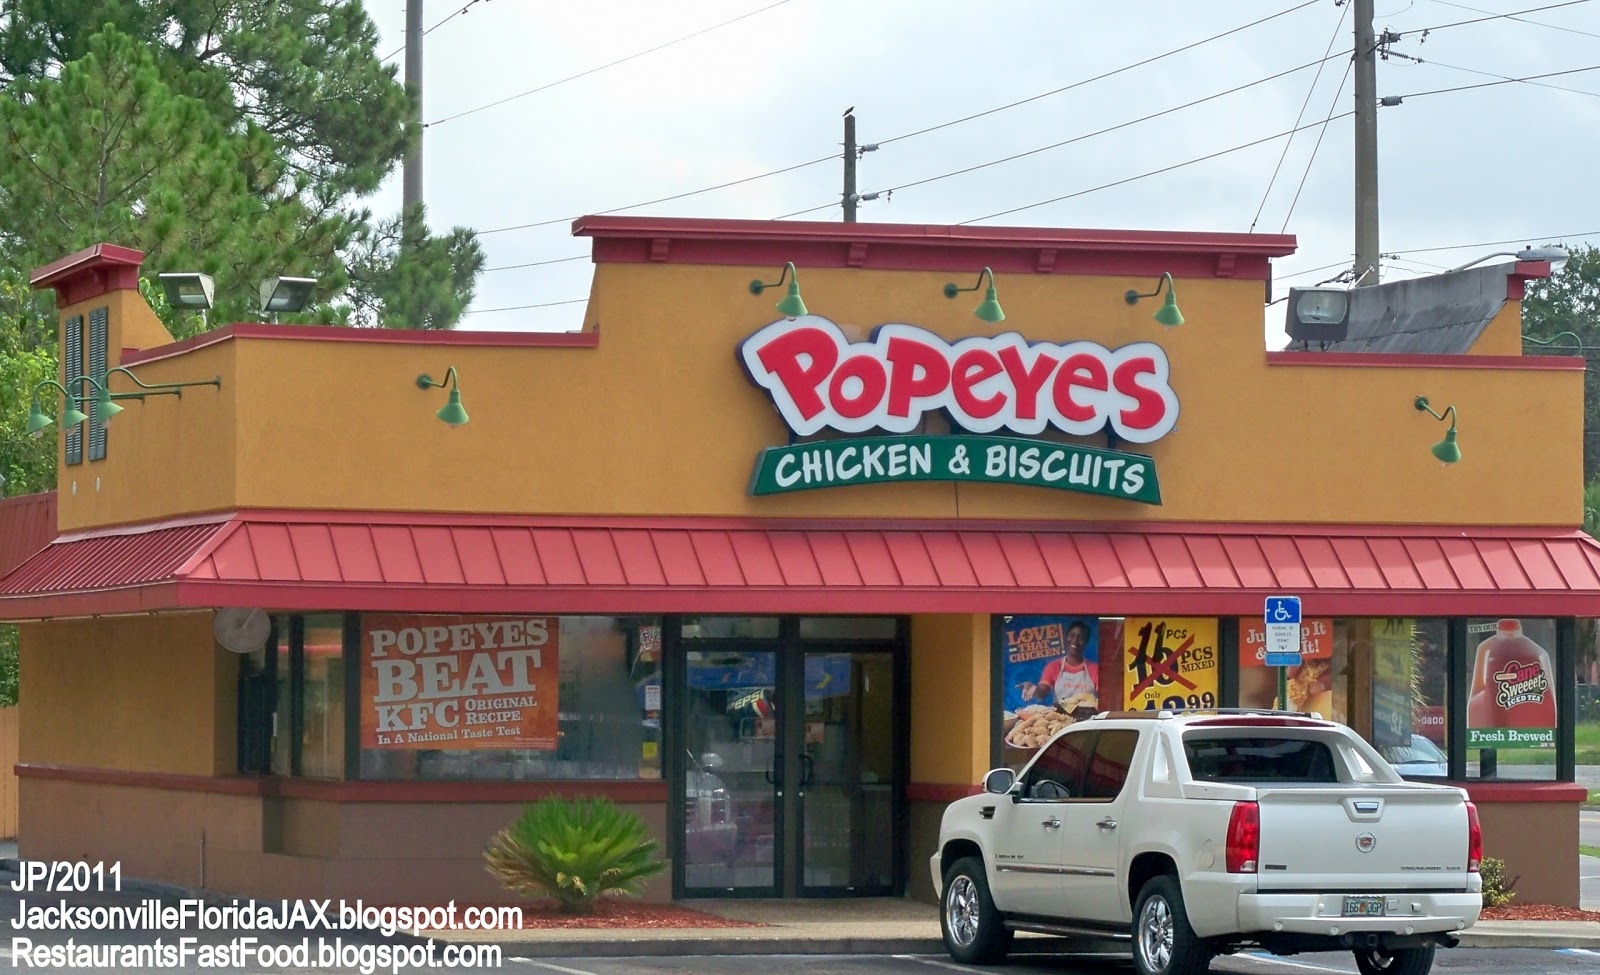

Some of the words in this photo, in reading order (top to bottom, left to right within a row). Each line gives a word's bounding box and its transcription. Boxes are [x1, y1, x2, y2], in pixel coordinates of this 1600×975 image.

[775, 443, 931, 487] CHICKEN
[949, 444, 970, 474] &
[985, 445, 1144, 494] BISCUITS
[1007, 624, 1060, 646] LOVE
[1166, 628, 1188, 640] PCS
[1312, 621, 1326, 636] It
[369, 619, 549, 657] POPEYES
[1018, 640, 1050, 652] THAT
[1180, 645, 1214, 664] PCS
[1302, 638, 1320, 655] It!
[1181, 659, 1215, 674] MIXED
[1506, 663, 1541, 686] Cane
[371, 649, 541, 703] BEAT
[464, 696, 537, 711] ORIGINAL
[1144, 691, 1161, 700] Only
[1507, 695, 1527, 707] ICED
[375, 700, 460, 733] KFC
[465, 711, 521, 725] RECIPE
[377, 735, 391, 744] In
[394, 734, 404, 744] A
[407, 730, 458, 743] National
[461, 728, 493, 739] Taste
[496, 726, 521, 736] Test
[1470, 729, 1505, 742] Fresh
[1508, 730, 1553, 742] Brewed
